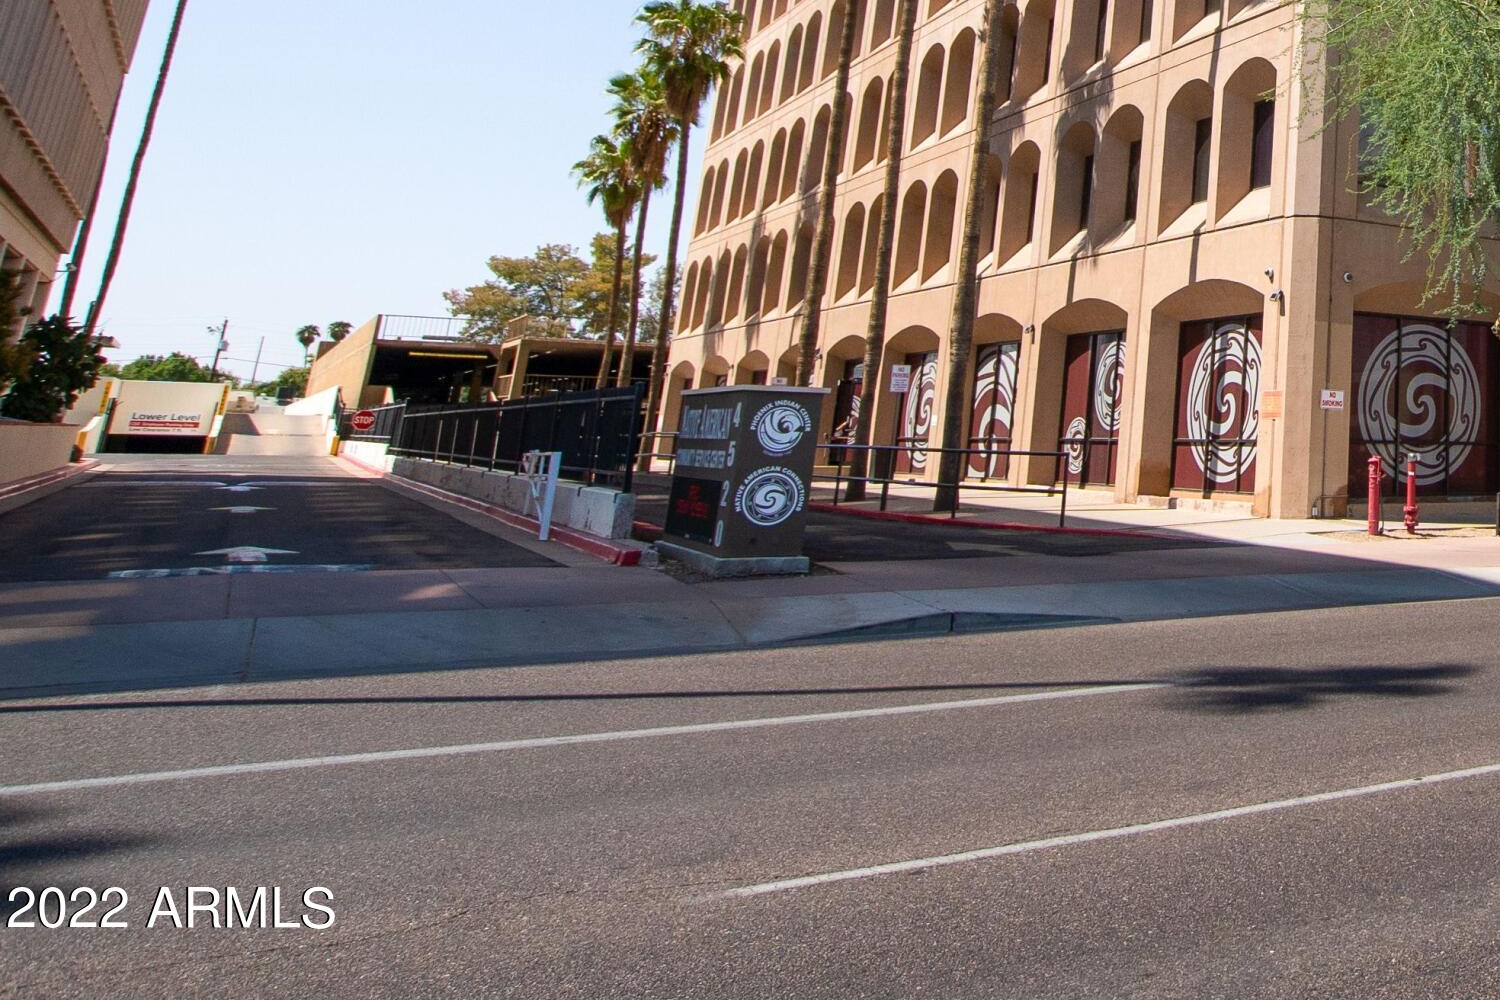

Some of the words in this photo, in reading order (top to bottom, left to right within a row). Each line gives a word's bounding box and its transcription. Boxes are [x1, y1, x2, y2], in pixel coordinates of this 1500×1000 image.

[131, 412, 168, 420] Lower
[171, 413, 201, 421] Level
[353, 416, 375, 424] STOP
[750, 402, 774, 430] PHOENIX
[774, 400, 800, 410] INDIAN
[799, 408, 812, 432] CENTER
[735, 485, 746, 512] NATIVE
[744, 466, 782, 484] AMERICAN
[782, 467, 805, 512] CONNECTIONS
